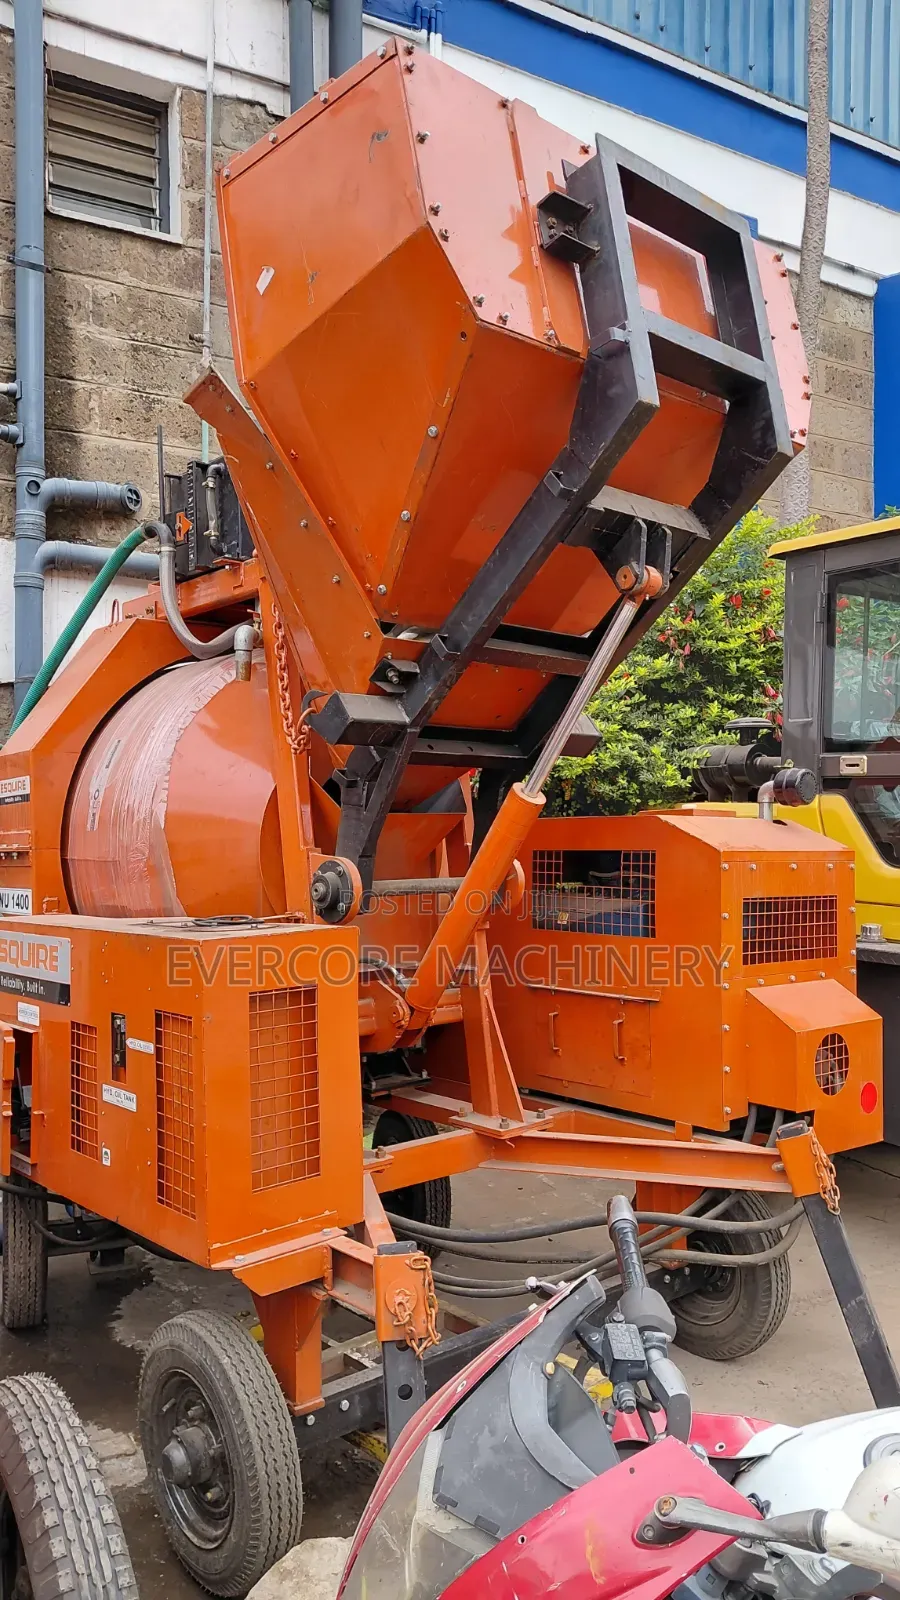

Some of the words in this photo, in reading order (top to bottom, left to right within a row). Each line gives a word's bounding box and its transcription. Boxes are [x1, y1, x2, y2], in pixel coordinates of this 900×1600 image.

[12, 893, 29, 910] 1400
[26, 978, 38, 994] Built
[123, 1093, 135, 1103] TANK
